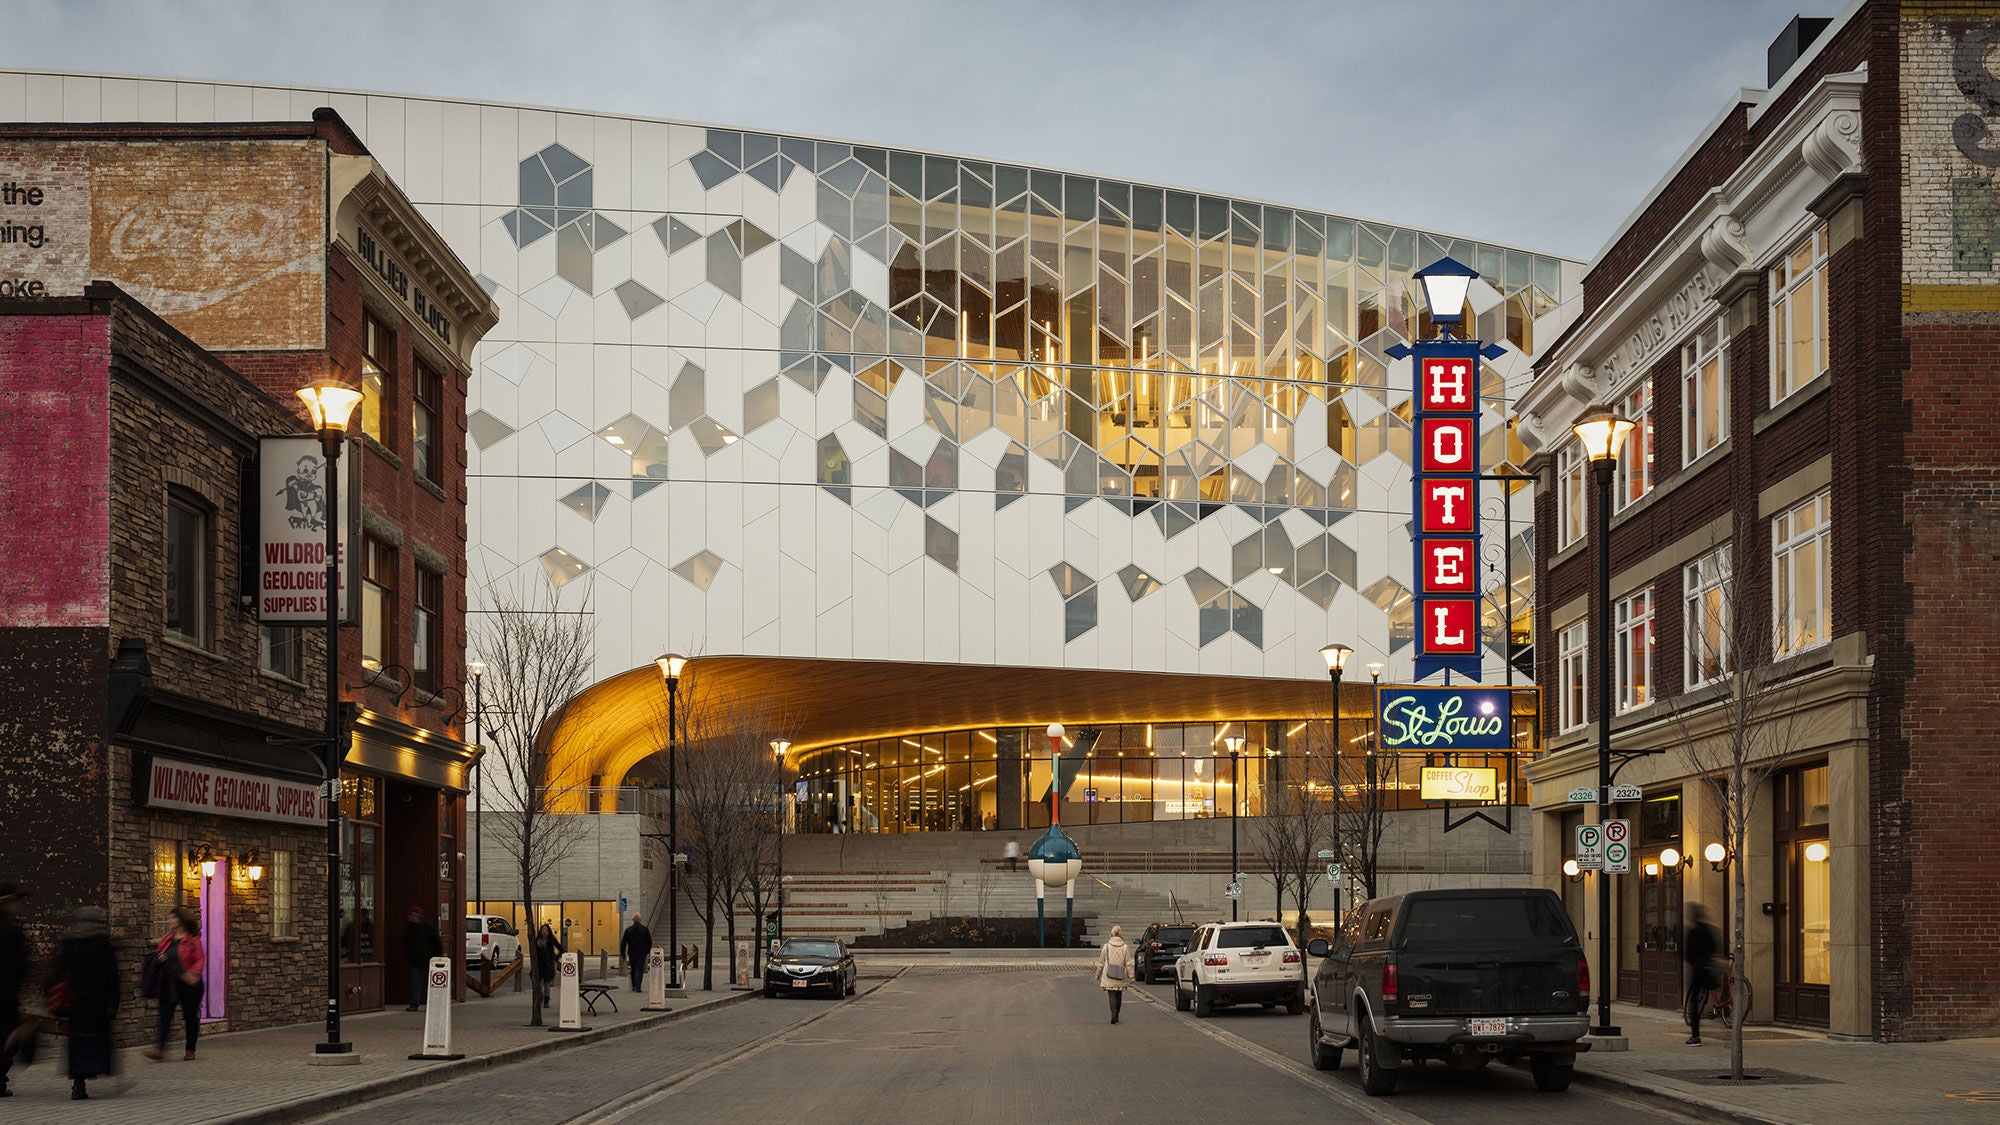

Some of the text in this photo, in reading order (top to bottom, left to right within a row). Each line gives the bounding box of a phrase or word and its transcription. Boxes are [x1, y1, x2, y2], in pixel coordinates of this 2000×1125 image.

[2, 182, 44, 206] the
[109, 203, 308, 261] Coca-Cola
[358, 226, 450, 345] HILLIER BLOCK
[1622, 314, 1667, 368] LOUIS
[1663, 266, 1720, 331] HOTEL
[1429, 365, 1466, 646] HOTEL
[264, 542, 344, 566] WILDROE
[263, 571, 345, 590] GEOLOGICL
[264, 596, 344, 613] SUPPLIES L.
[1421, 696, 1502, 745] Louis
[1426, 770, 1453, 780] COFFEE
[1446, 770, 1490, 797] Shop
[153, 765, 211, 806] WILDROSE
[214, 775, 271, 813] GEOLOGICAL
[276, 785, 316, 819] SUPPLIES
[1573, 792, 1593, 800] 2326
[1616, 789, 1637, 798] 2327
